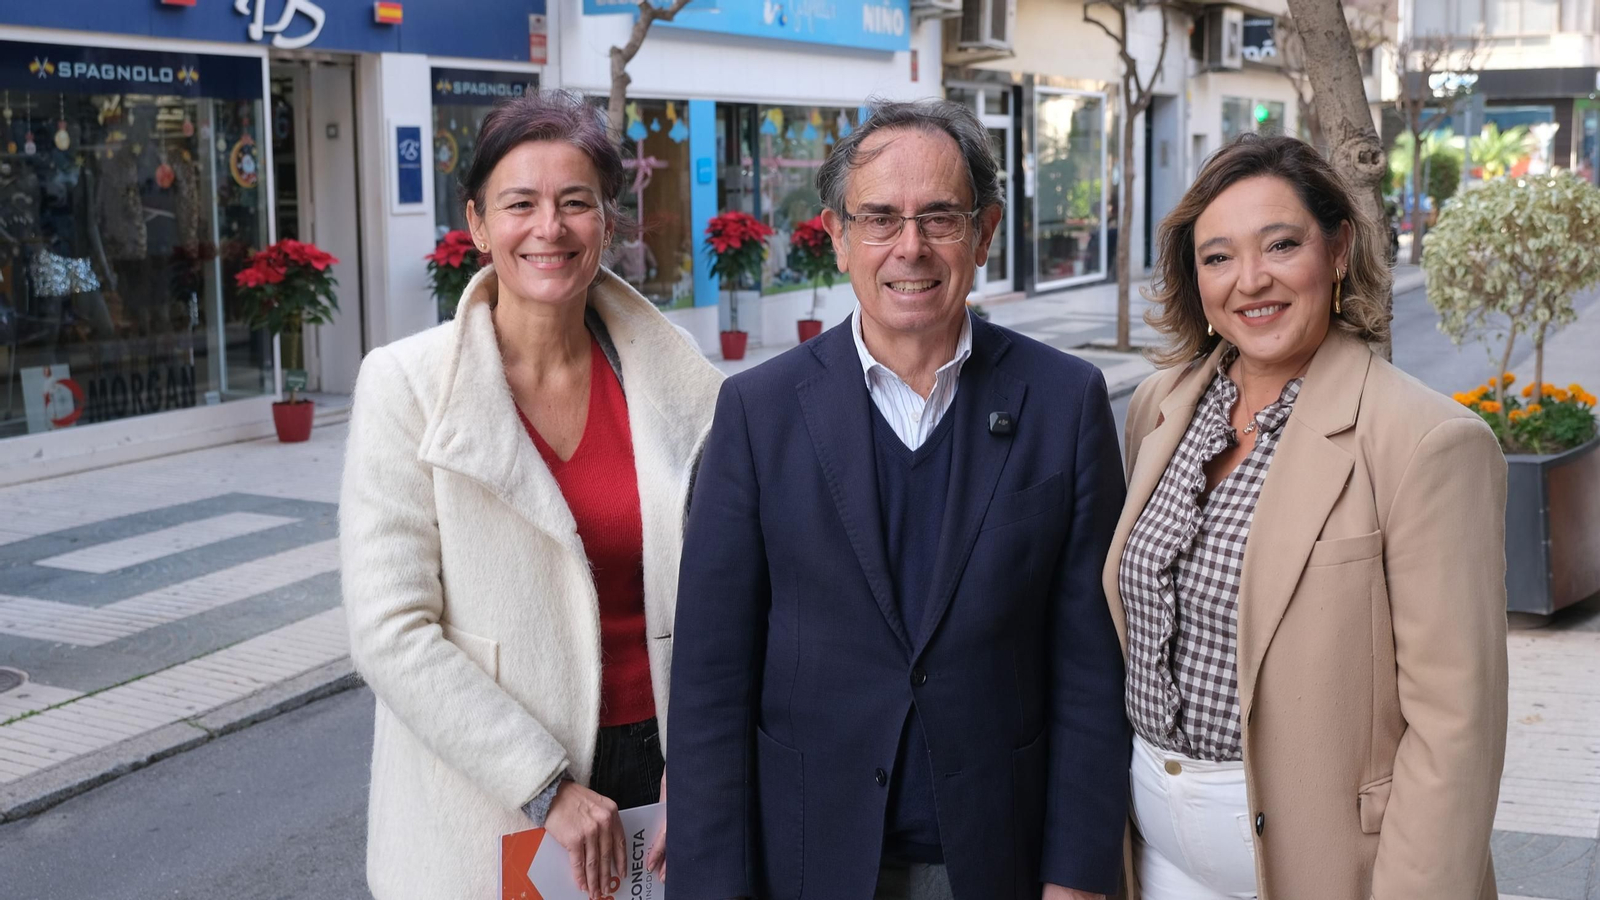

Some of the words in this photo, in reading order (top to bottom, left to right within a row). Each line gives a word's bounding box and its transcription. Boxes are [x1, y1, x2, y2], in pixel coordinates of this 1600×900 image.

[58, 61, 173, 83] SPAGNOLO
[453, 81, 523, 96] SPAGNOLO
[88, 364, 197, 423] MORGAN
